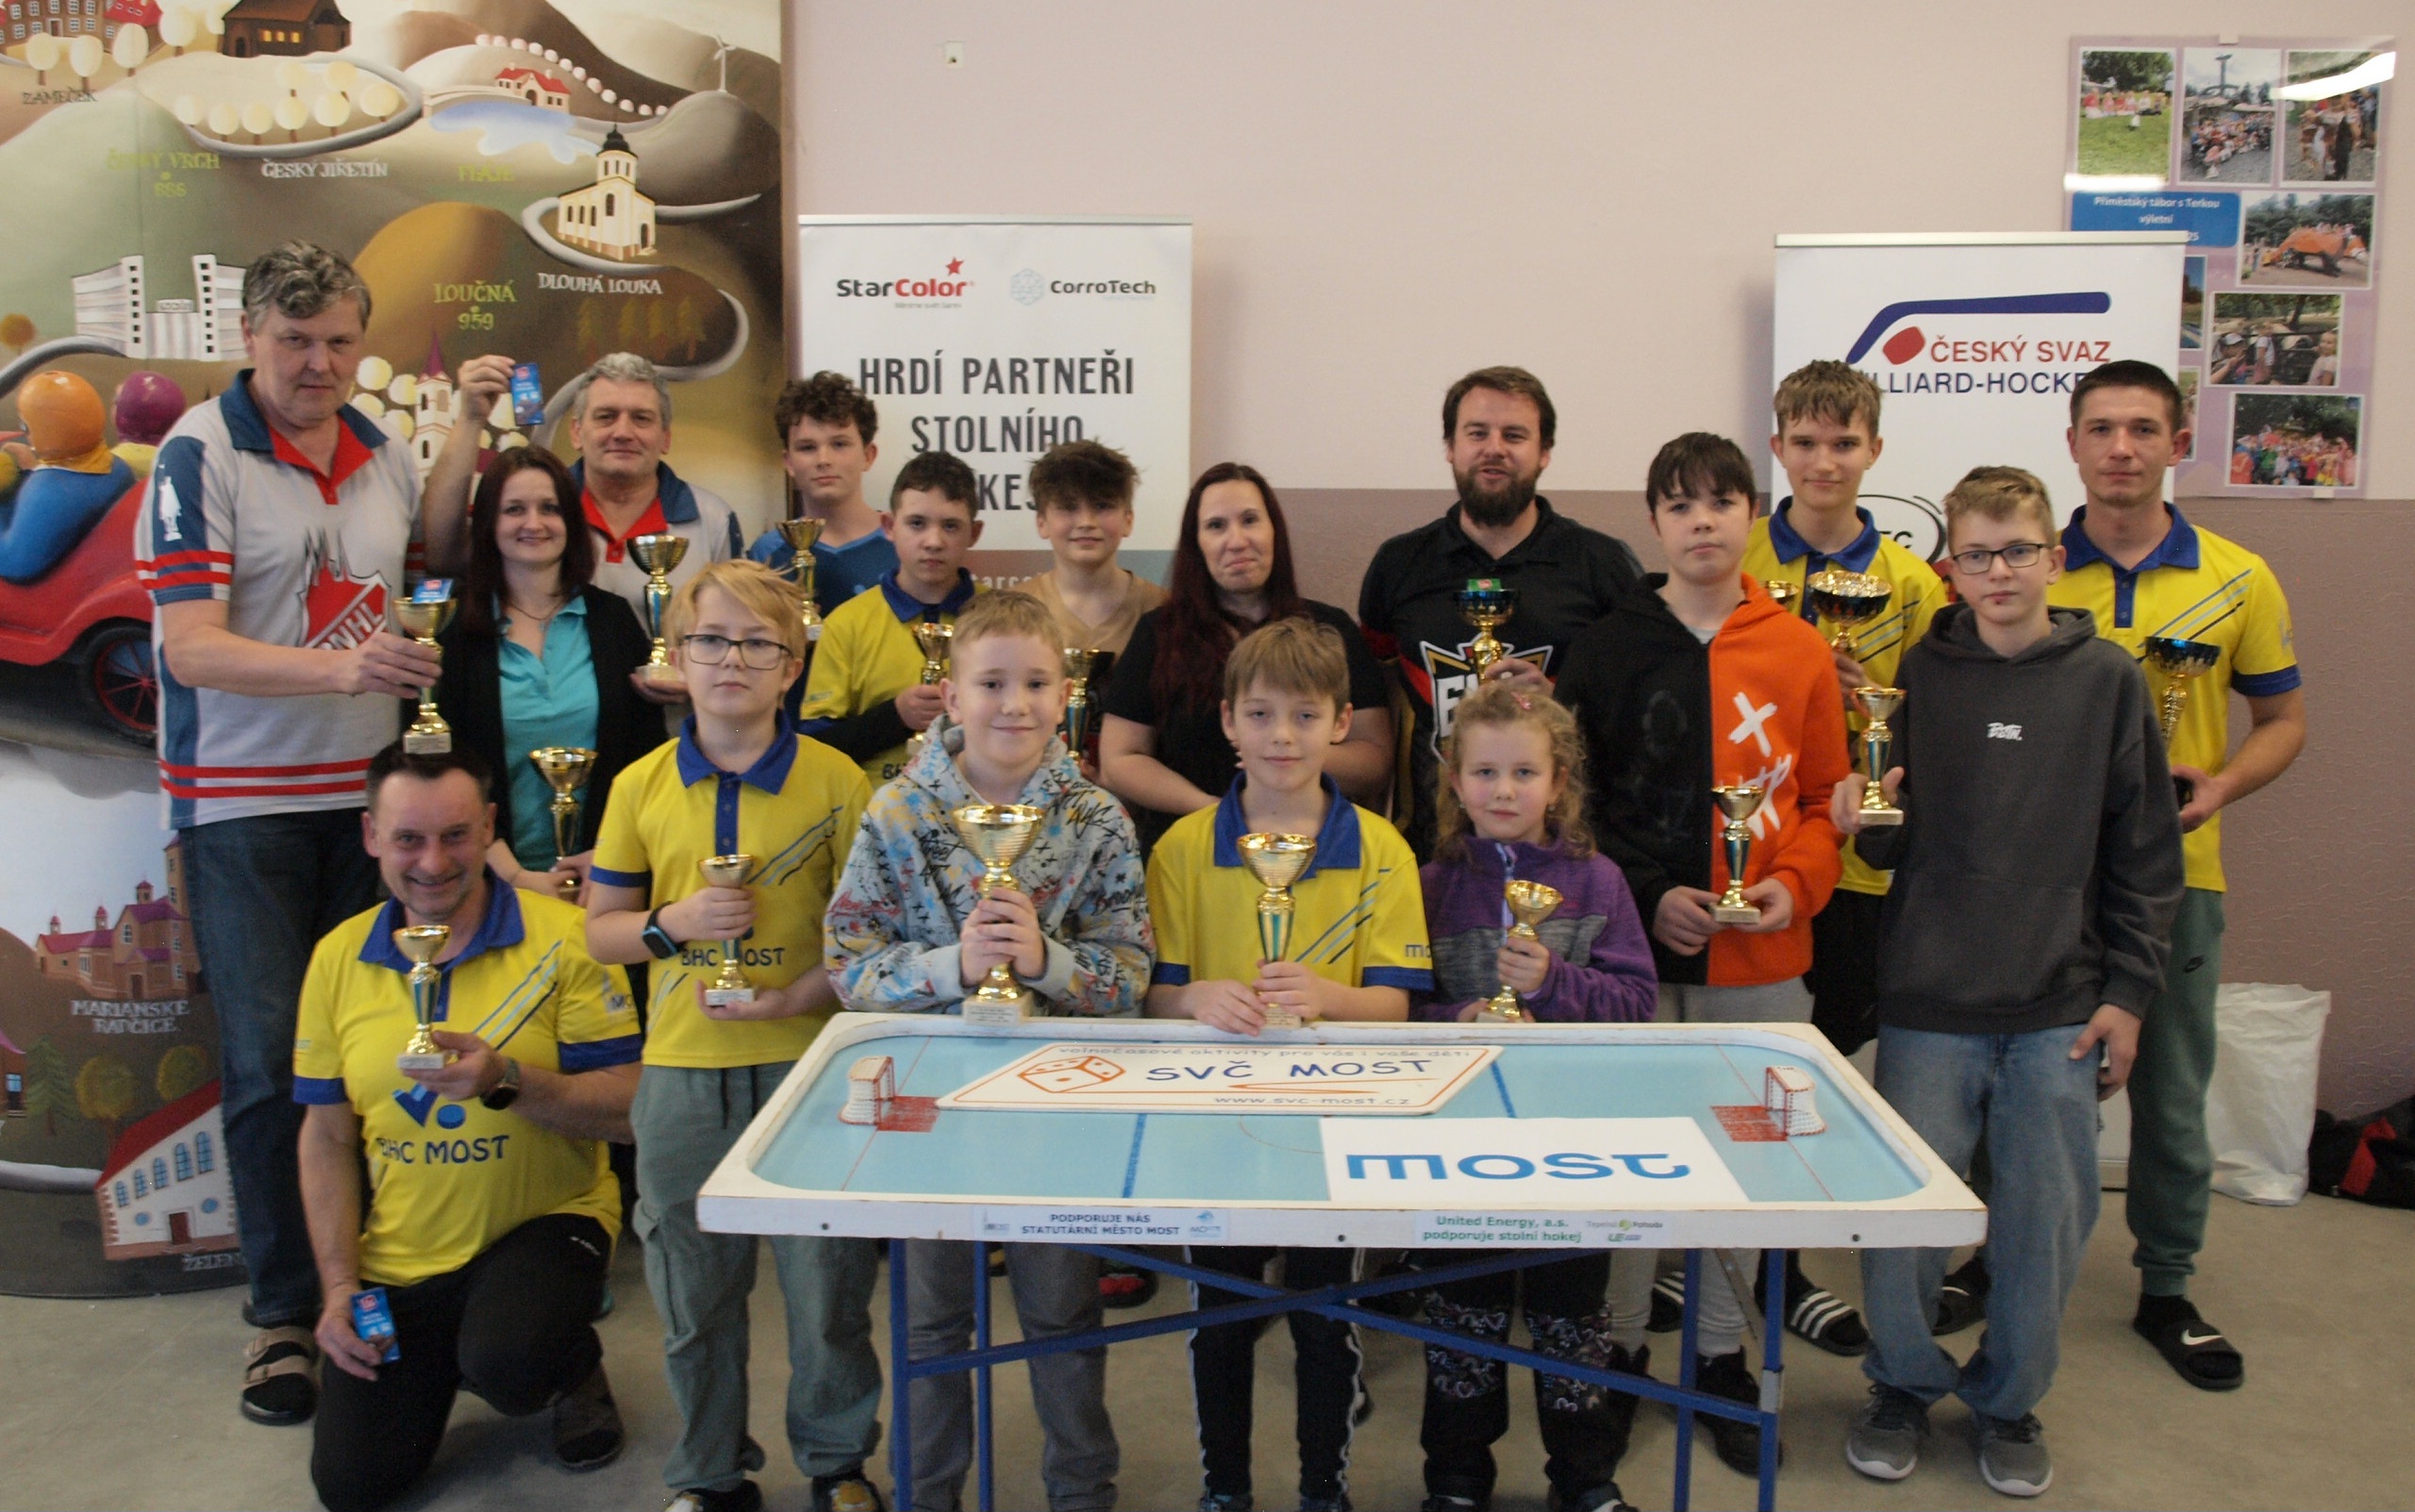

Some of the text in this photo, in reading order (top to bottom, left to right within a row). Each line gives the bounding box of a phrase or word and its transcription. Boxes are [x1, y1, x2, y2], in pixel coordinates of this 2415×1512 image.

[170, 153, 221, 170] VRCH
[261, 158, 317, 178] ČESKÝ
[2093, 195, 2147, 208] Příměstský
[2150, 196, 2176, 208] tábor
[2186, 197, 2221, 208] Terkou
[2138, 213, 2174, 226] výletní
[433, 280, 518, 304] LOUČNÁ
[538, 272, 663, 295] DLOUHÁ LOUKA
[837, 278, 967, 297] StarColor
[1050, 279, 1157, 294] CorroTech
[458, 312, 495, 330] 959
[1930, 335, 2111, 363] ČESKÝ SVAZ
[859, 349, 1134, 394] HRDÍ PARTNEŘI
[1865, 372, 2089, 394] LLIARD-HOCK
[911, 407, 1085, 454] STOLNÍHO
[680, 947, 786, 967] BHC OST
[1059, 1047, 1183, 1055] volnočasové
[1191, 1048, 1272, 1057] aktivity
[1146, 1059, 1432, 1082] SVČ MOST
[1214, 1096, 1410, 1105] www.svc-most.cz
[425, 1135, 510, 1165] MOST
[1346, 1153, 1691, 1180] most
[1051, 1211, 1151, 1224] PODPORUJE NÁS
[1436, 1216, 1570, 1229] United Energy, a.s.
[1022, 1223, 1098, 1235] STATUTÁRNÍ
[1102, 1224, 1142, 1236] MĚSTO
[1147, 1226, 1180, 1236] MOST
[1423, 1230, 1583, 1243] podporuje stolní hokej
